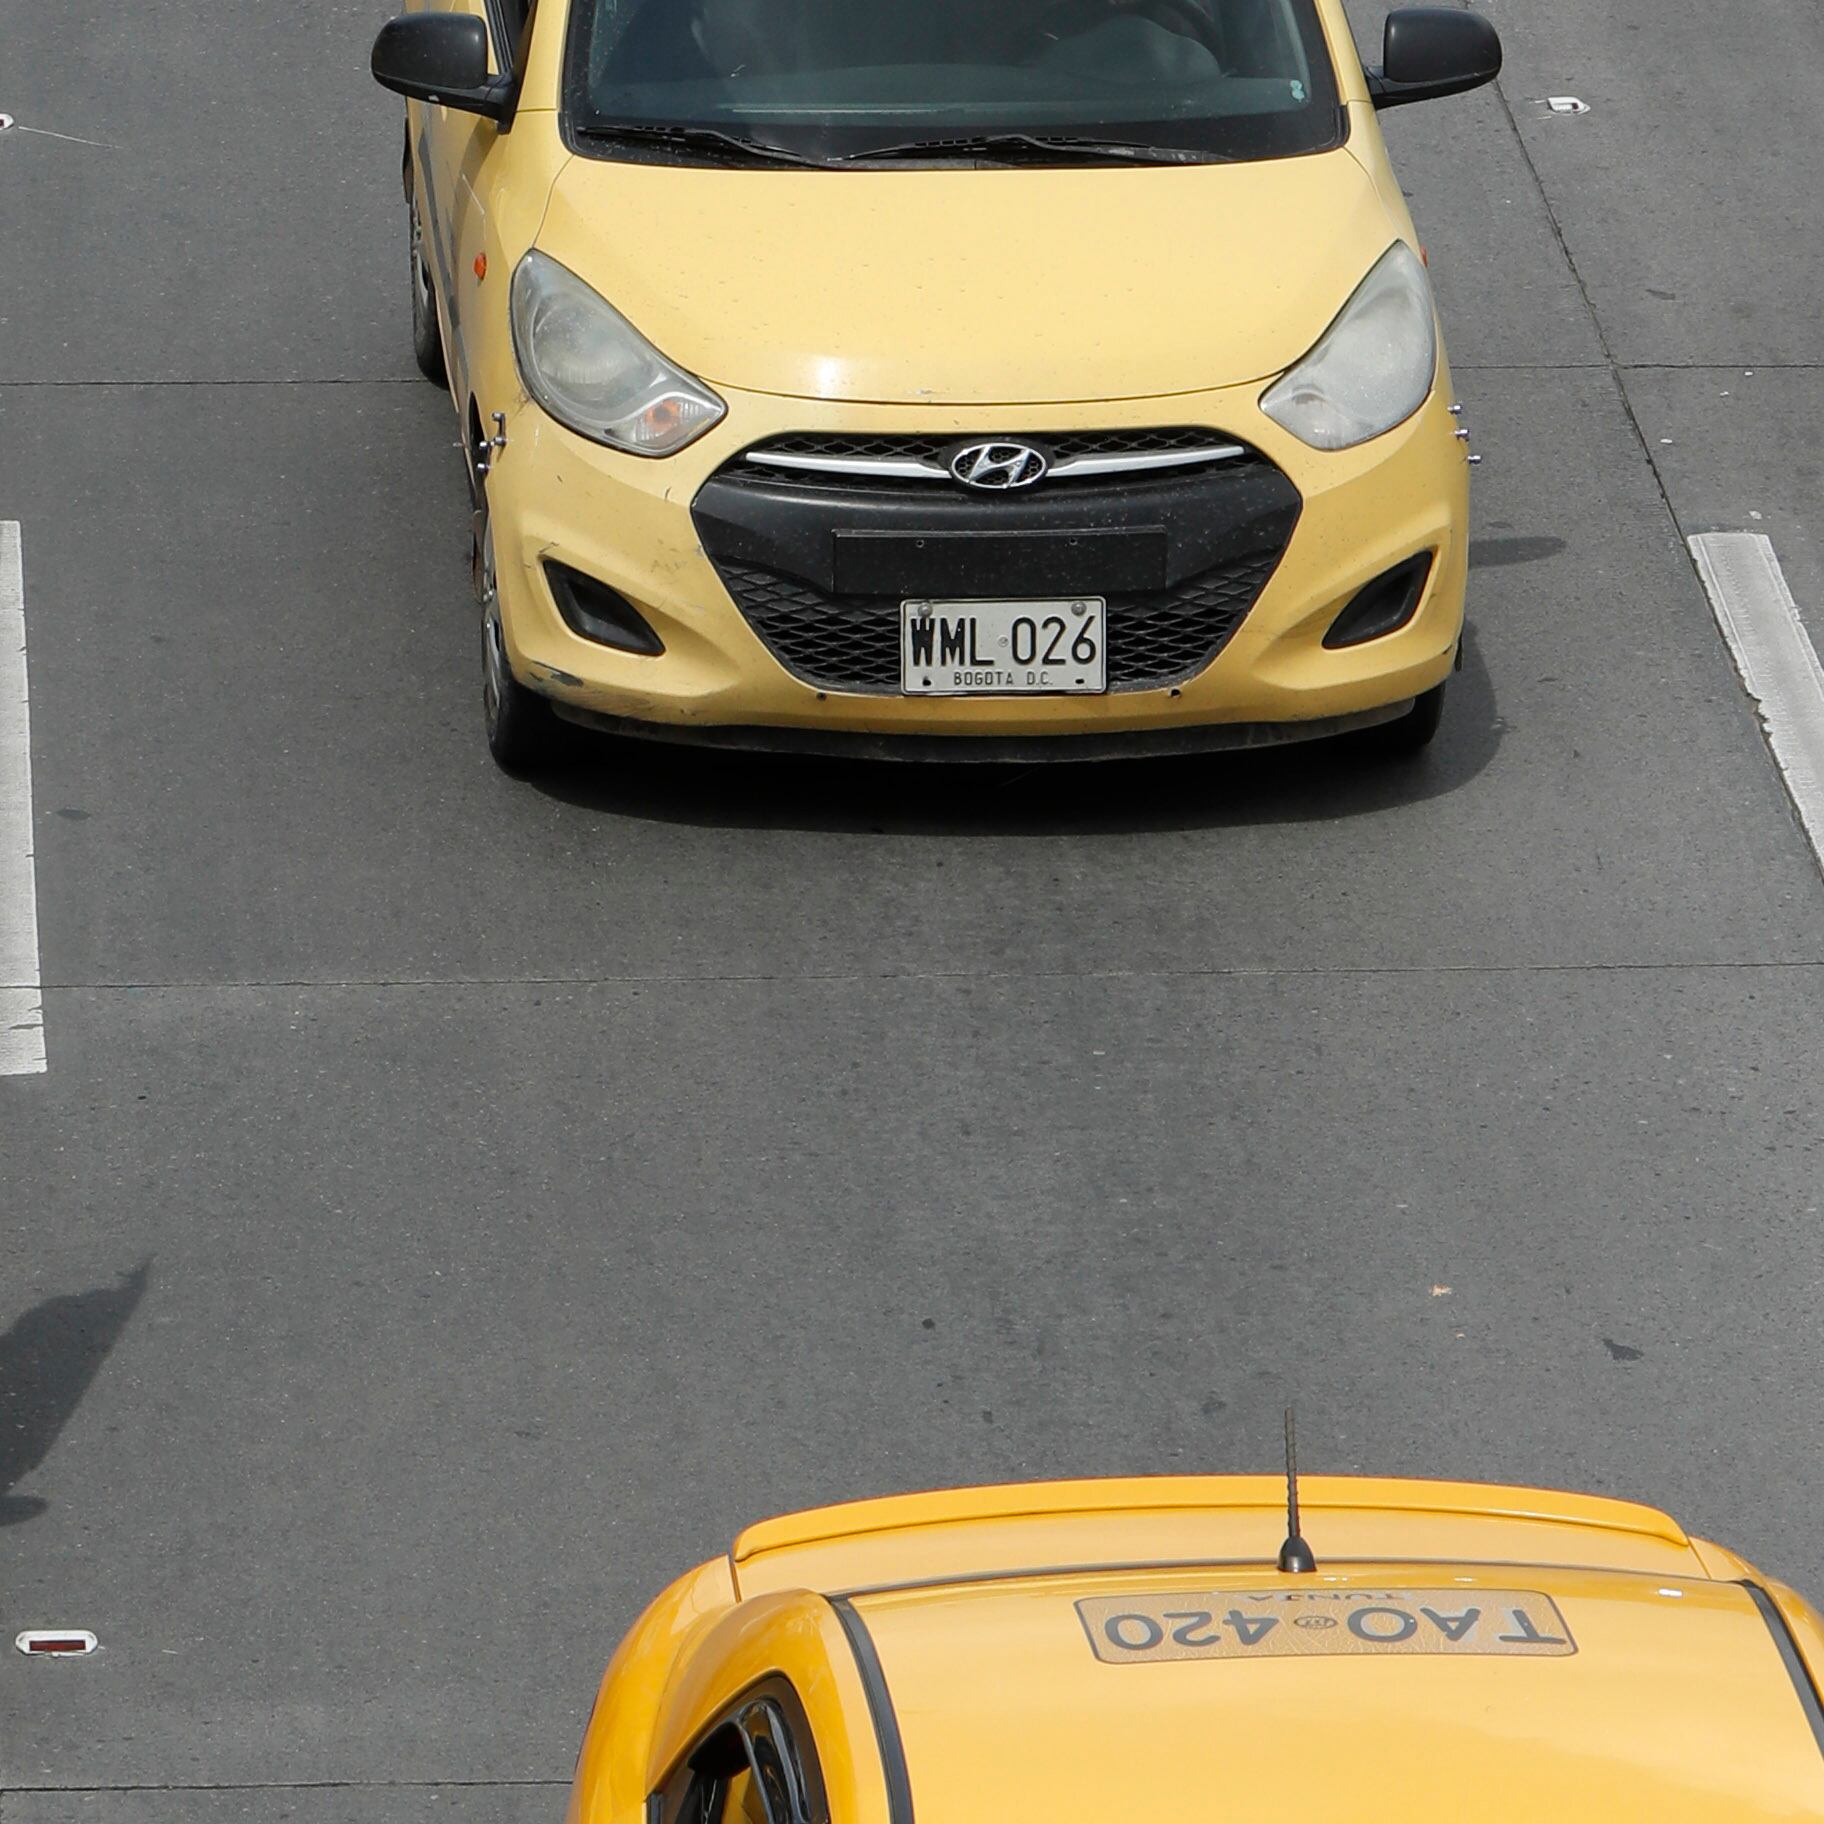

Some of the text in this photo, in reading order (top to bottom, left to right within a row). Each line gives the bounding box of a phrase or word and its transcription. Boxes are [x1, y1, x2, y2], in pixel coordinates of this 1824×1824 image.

[909, 615, 1097, 667] WML 026
[953, 670, 1054, 687] BOGOTA D.C.
[1102, 1605, 1568, 1651] TAO 420
